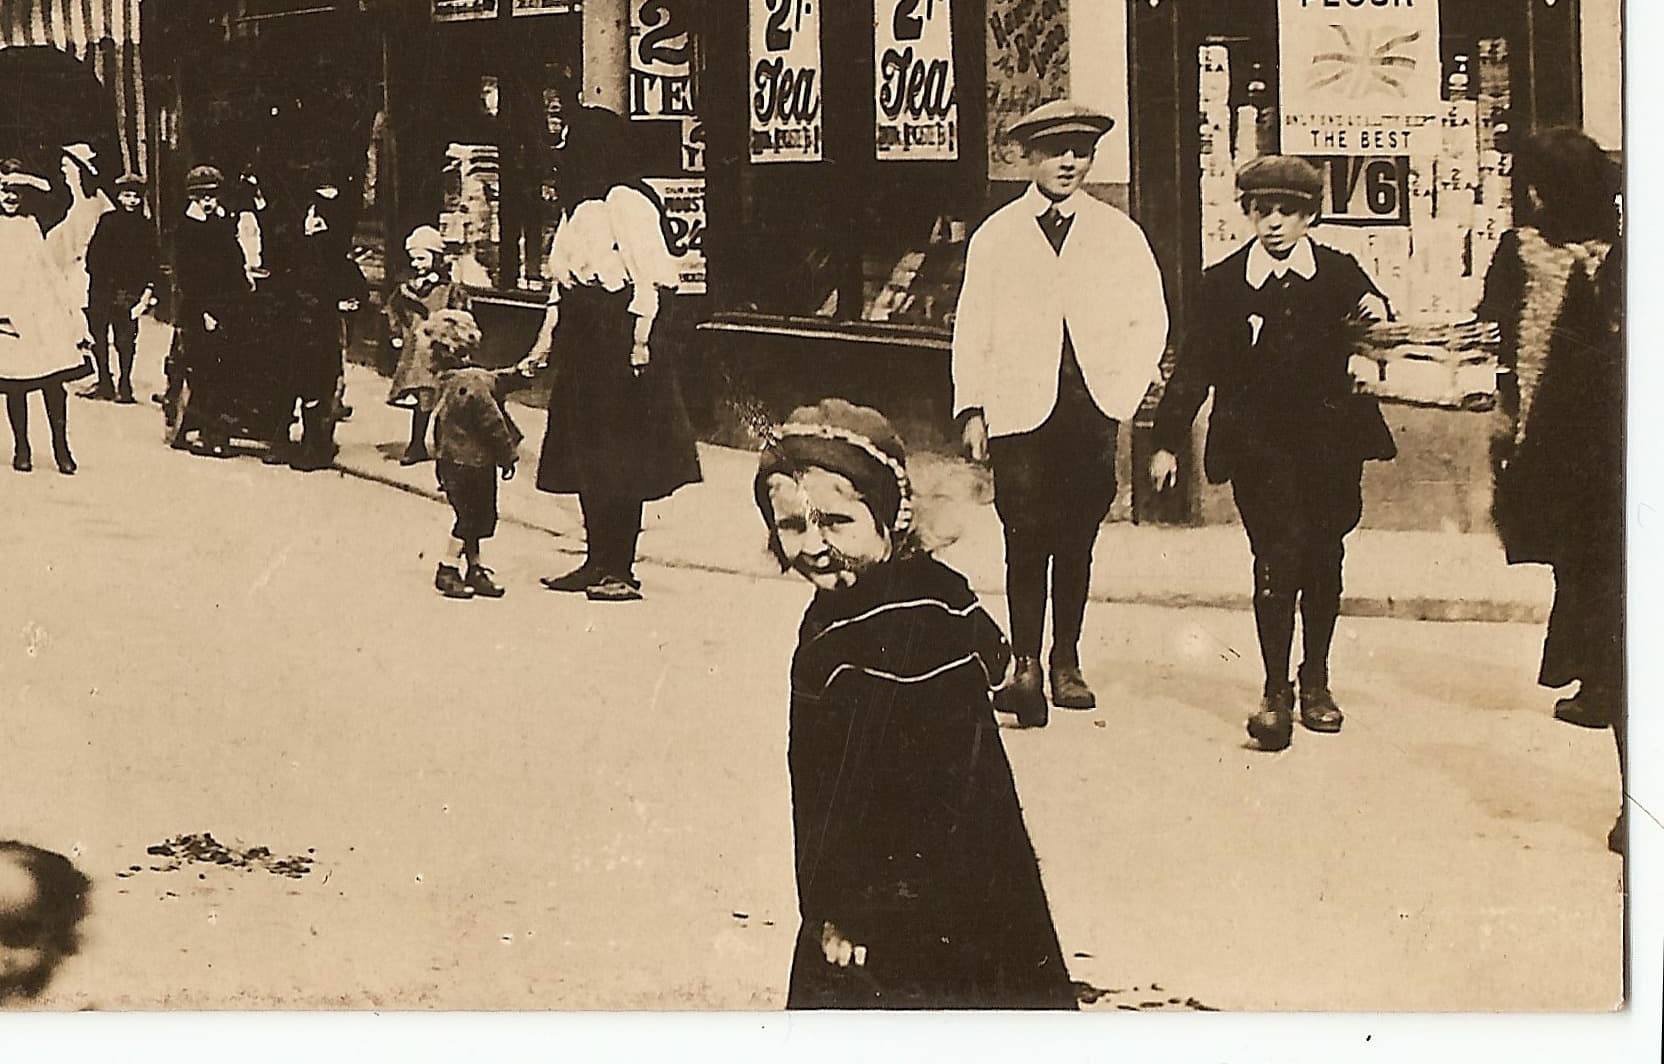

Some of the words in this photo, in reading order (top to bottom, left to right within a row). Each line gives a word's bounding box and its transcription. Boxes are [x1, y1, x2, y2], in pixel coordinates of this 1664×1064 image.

[753, 55, 820, 126] Tea
[879, 45, 956, 122] Tea
[1310, 130, 1348, 149] THE
[1360, 130, 1412, 149] BEST
[1331, 157, 1398, 215] 1/6
